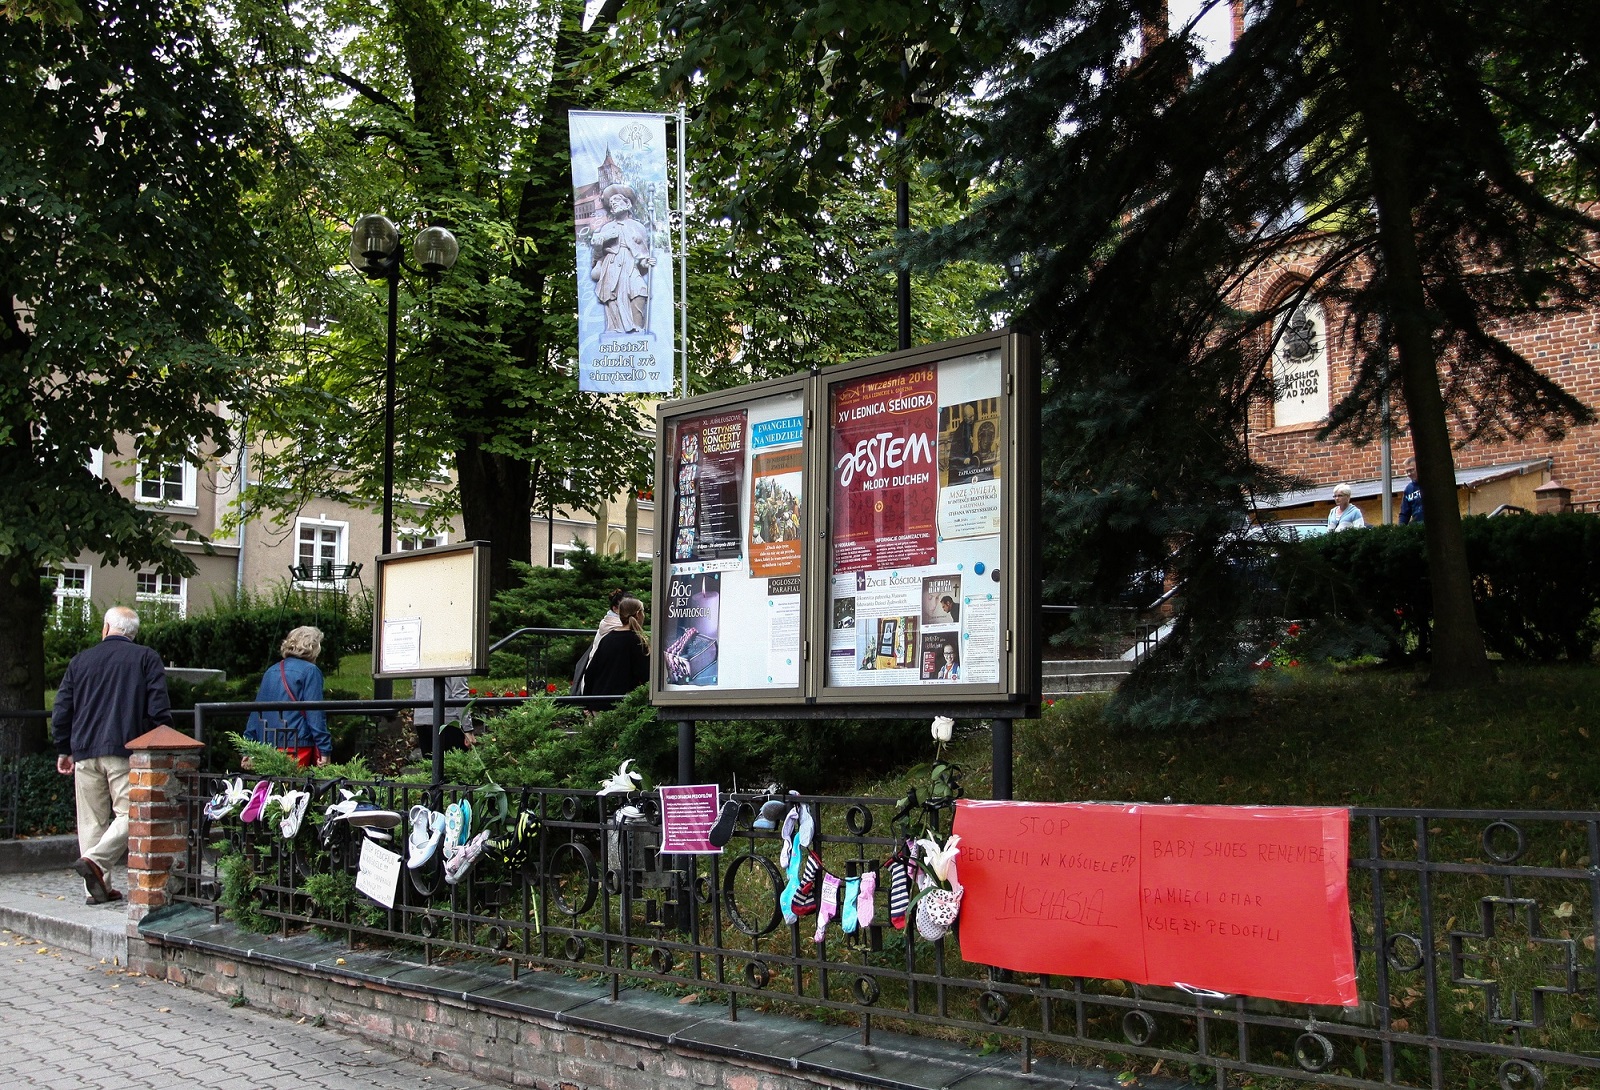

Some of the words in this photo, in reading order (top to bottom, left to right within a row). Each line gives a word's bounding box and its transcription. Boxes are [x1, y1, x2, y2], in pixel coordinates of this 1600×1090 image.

[861, 383, 865, 393] 1
[868, 376, 906, 392] września
[908, 370, 934, 384] 2018
[1285, 370, 1319, 382] BASILICA
[1285, 378, 1318, 389] MINOR
[1286, 390, 1298, 399] AD
[1300, 386, 1318, 396] 2004
[838, 410, 850, 422] XV
[852, 402, 885, 420] LEDNICA
[889, 394, 933, 412] SENIORA
[702, 423, 742, 435] OLSZTYŃSKIE
[758, 419, 802, 433] EWANGELIA
[703, 432, 741, 446] KONCERTY
[703, 440, 740, 453] ORGANOWE
[863, 478, 890, 491] MŁODY
[892, 472, 929, 486] DUCHEM
[970, 485, 997, 496] ŚWIĘTĄ
[671, 580, 692, 597] BÓG
[676, 598, 688, 607] JEST
[1017, 817, 1070, 836] STOP
[960, 846, 1029, 866] PEDOFILII
[1040, 854, 1050, 866] W
[1153, 840, 1196, 858] BABY
[1204, 841, 1248, 858] SHOES
[1258, 844, 1339, 864] REMEMBER
[1144, 888, 1210, 908] PAMIĘCI
[1219, 892, 1262, 906] OFIAR
[1206, 920, 1280, 942] PEDOFILI
